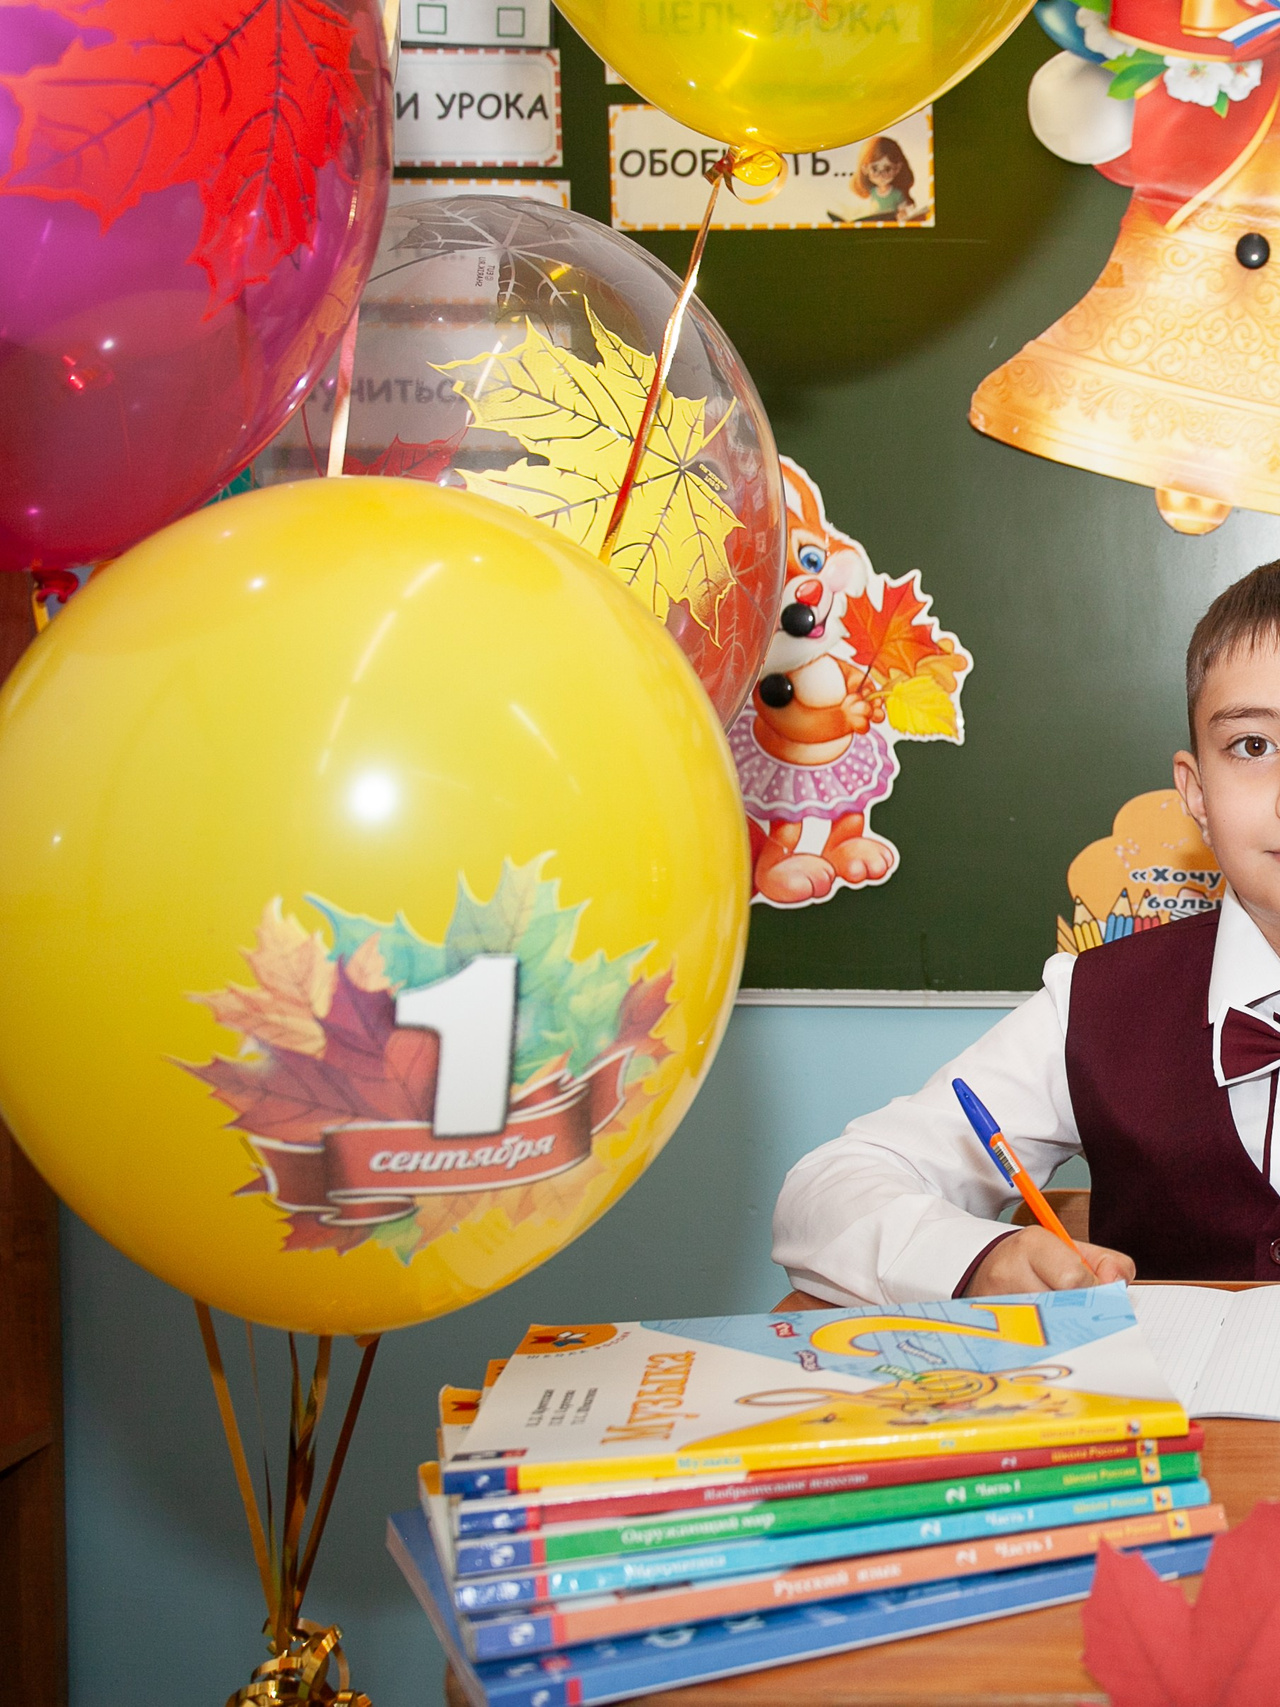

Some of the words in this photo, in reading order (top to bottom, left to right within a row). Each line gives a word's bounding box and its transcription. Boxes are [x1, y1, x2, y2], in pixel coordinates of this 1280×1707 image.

[436, 93, 549, 120] УРОКА
[1147, 898, 1221, 910] боль
[395, 954, 518, 1138] 1
[369, 1135, 555, 1174] сентября
[600, 1351, 700, 1446] Музыка
[773, 1570, 849, 1598] Русский
[857, 1563, 901, 1582] язык
